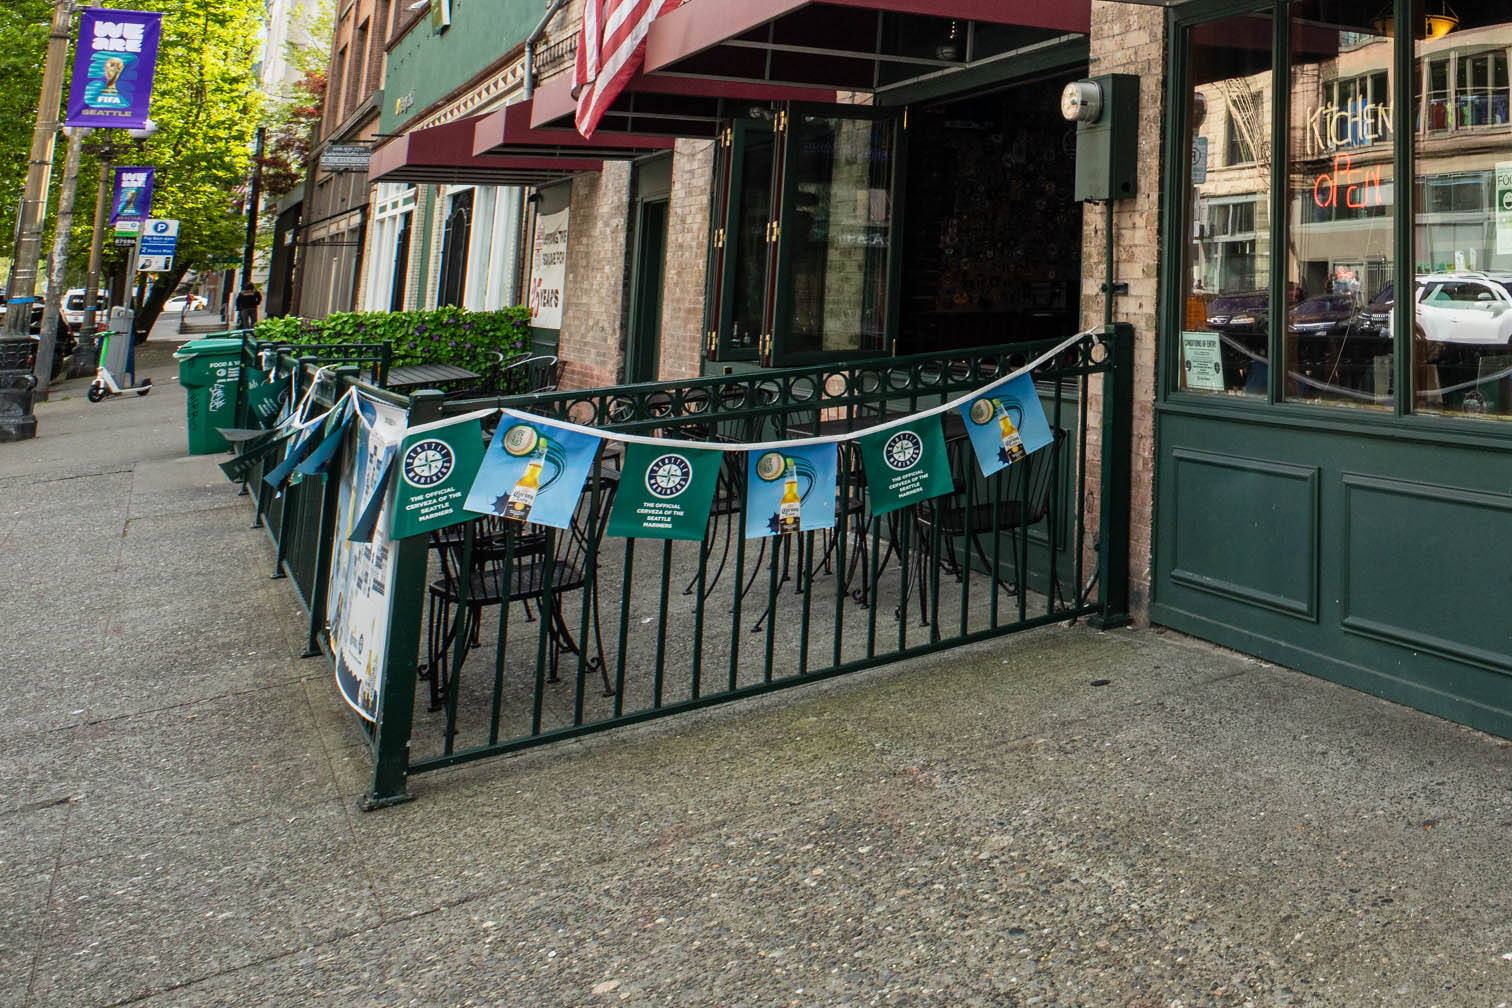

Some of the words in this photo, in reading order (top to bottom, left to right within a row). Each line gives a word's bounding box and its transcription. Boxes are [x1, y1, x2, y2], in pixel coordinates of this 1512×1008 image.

[96, 95, 121, 104] FIFA
[81, 109, 132, 117] SEATTLE
[157, 223, 166, 232] P
[209, 361, 228, 369] FOOD
[887, 434, 918, 451] SEATTLE
[406, 443, 448, 464] SEATTLE
[652, 457, 689, 472] SEATTLE
[902, 469, 924, 479] OFFICIAL
[889, 480, 911, 490] CERVEZA
[899, 482, 921, 492] SEATTLE
[410, 494, 425, 503] THE
[425, 486, 456, 499] OFFICIAL
[898, 487, 924, 499] MARINERS
[405, 498, 438, 511] CERVEZA
[449, 491, 462, 500] THE
[420, 501, 450, 514] SEATTLE
[636, 508, 663, 516] CERVEZA
[418, 508, 454, 523] MARINERS
